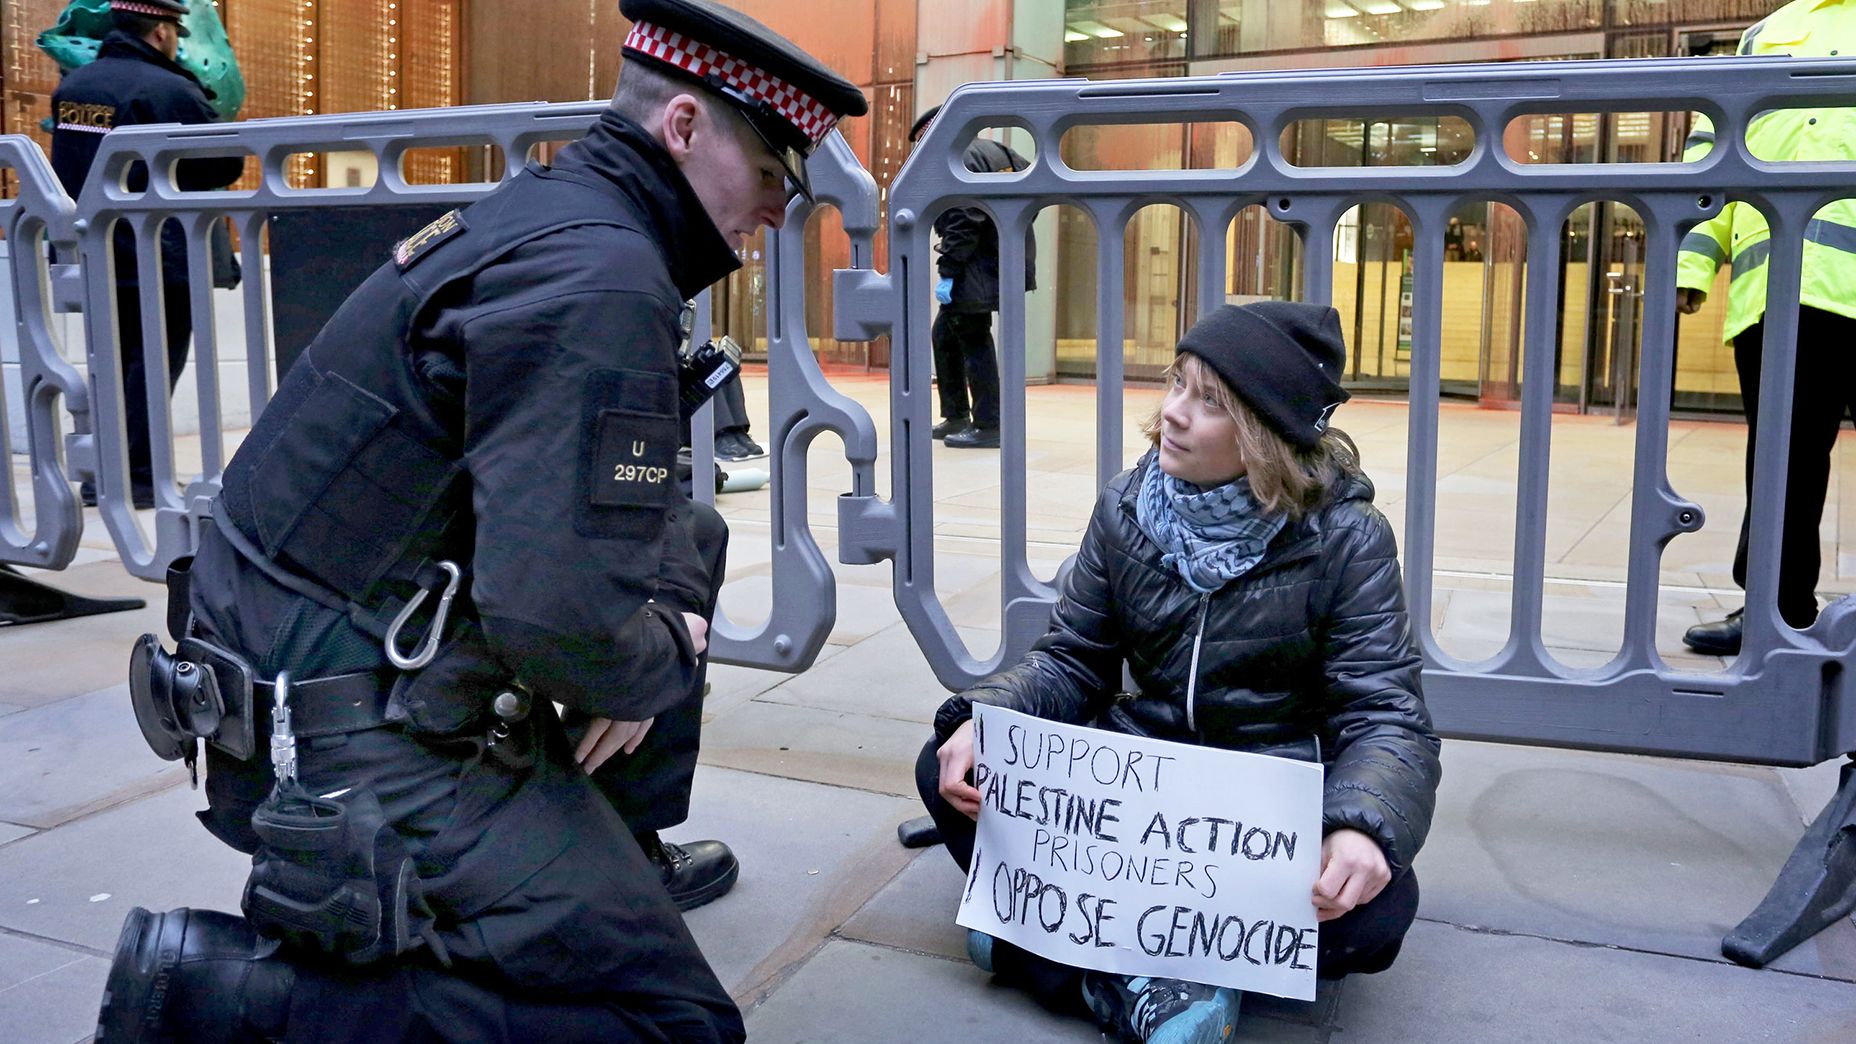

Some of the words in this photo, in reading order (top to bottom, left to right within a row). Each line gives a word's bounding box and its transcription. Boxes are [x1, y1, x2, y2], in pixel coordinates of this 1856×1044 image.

[58, 108, 113, 128] POLICE
[614, 464, 668, 484] 297CP
[632, 440, 645, 457] U
[1003, 724, 1177, 793] SUPPORT
[975, 762, 1123, 843] PALESTINE
[1139, 811, 1298, 862] ACTION
[1032, 828, 1220, 899] PRISONERS
[965, 847, 982, 904] I
[992, 861, 1118, 948] OPPOSE
[1136, 905, 1318, 971] GENOCIDE
